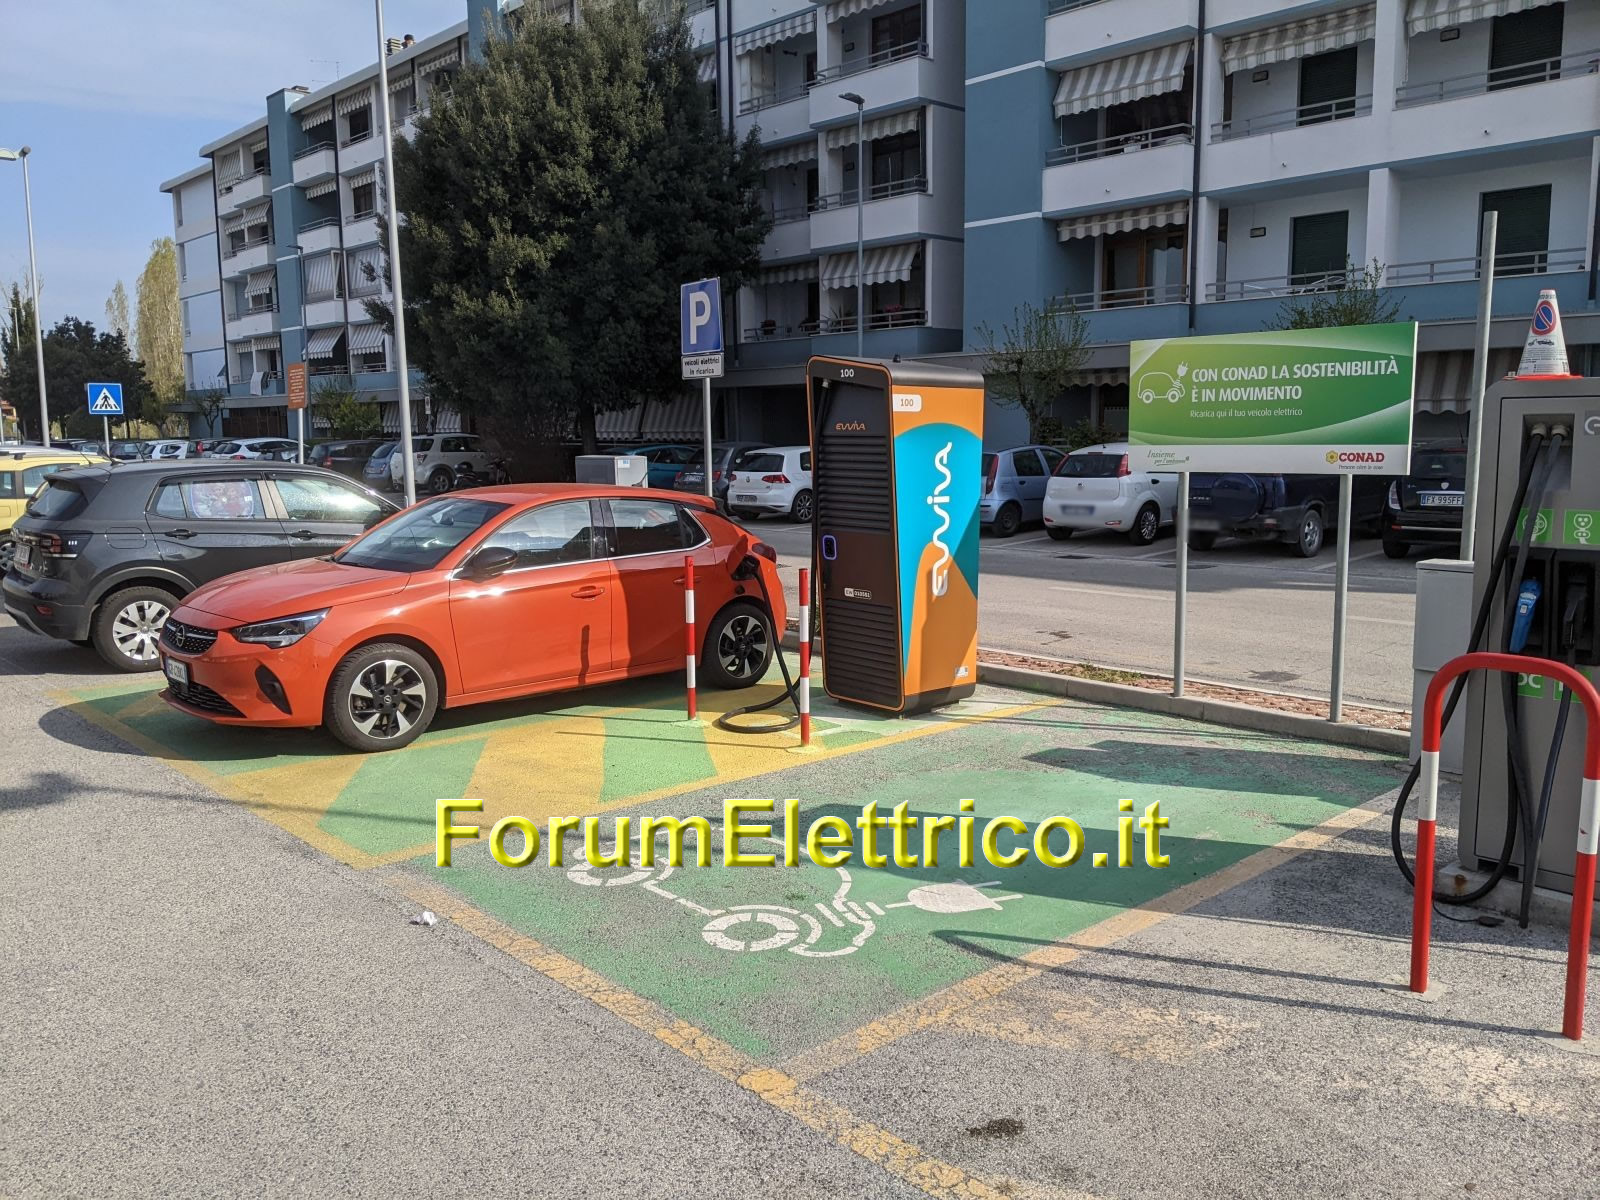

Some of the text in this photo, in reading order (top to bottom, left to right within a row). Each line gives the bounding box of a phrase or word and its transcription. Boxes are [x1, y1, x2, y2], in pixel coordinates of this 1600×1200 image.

[689, 291, 711, 345] P
[683, 358, 700, 367] veicoli
[840, 368, 855, 378] 100
[1191, 355, 1399, 382] CON CONAD LA SOSTENIBILITÀ
[1191, 385, 1302, 403] È IN MOVIMENTO
[900, 398, 914, 407] 100
[1190, 407, 1303, 419] Ricarica qui il tuo veicolo elettrico
[1338, 452, 1385, 463] CONAD
